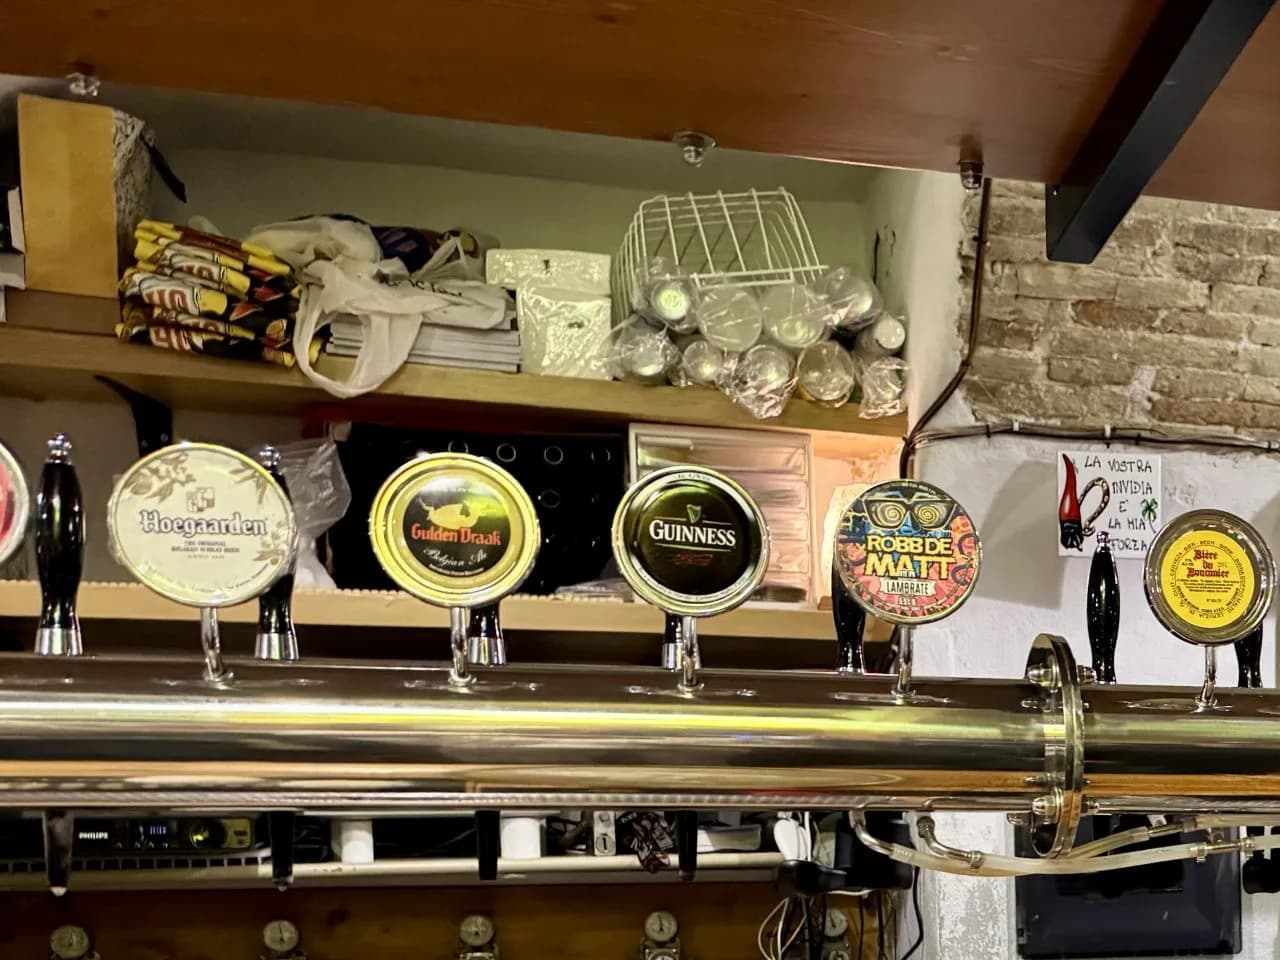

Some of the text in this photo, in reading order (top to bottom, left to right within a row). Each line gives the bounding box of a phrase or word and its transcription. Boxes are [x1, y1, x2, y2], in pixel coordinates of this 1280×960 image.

[1084, 456, 1152, 473] LA VOSTRA
[1112, 480, 1153, 495] INVIDIA
[139, 508, 268, 539] Hoegaarden
[1108, 518, 1146, 530] LA MIA
[411, 523, 501, 546] Gulden Draak
[649, 519, 736, 547] GUINNESS
[866, 535, 925, 554] ROBB
[864, 553, 957, 580] MATT
[886, 580, 929, 595] LAMBRATE
[78, 831, 109, 840] PHILIPS
